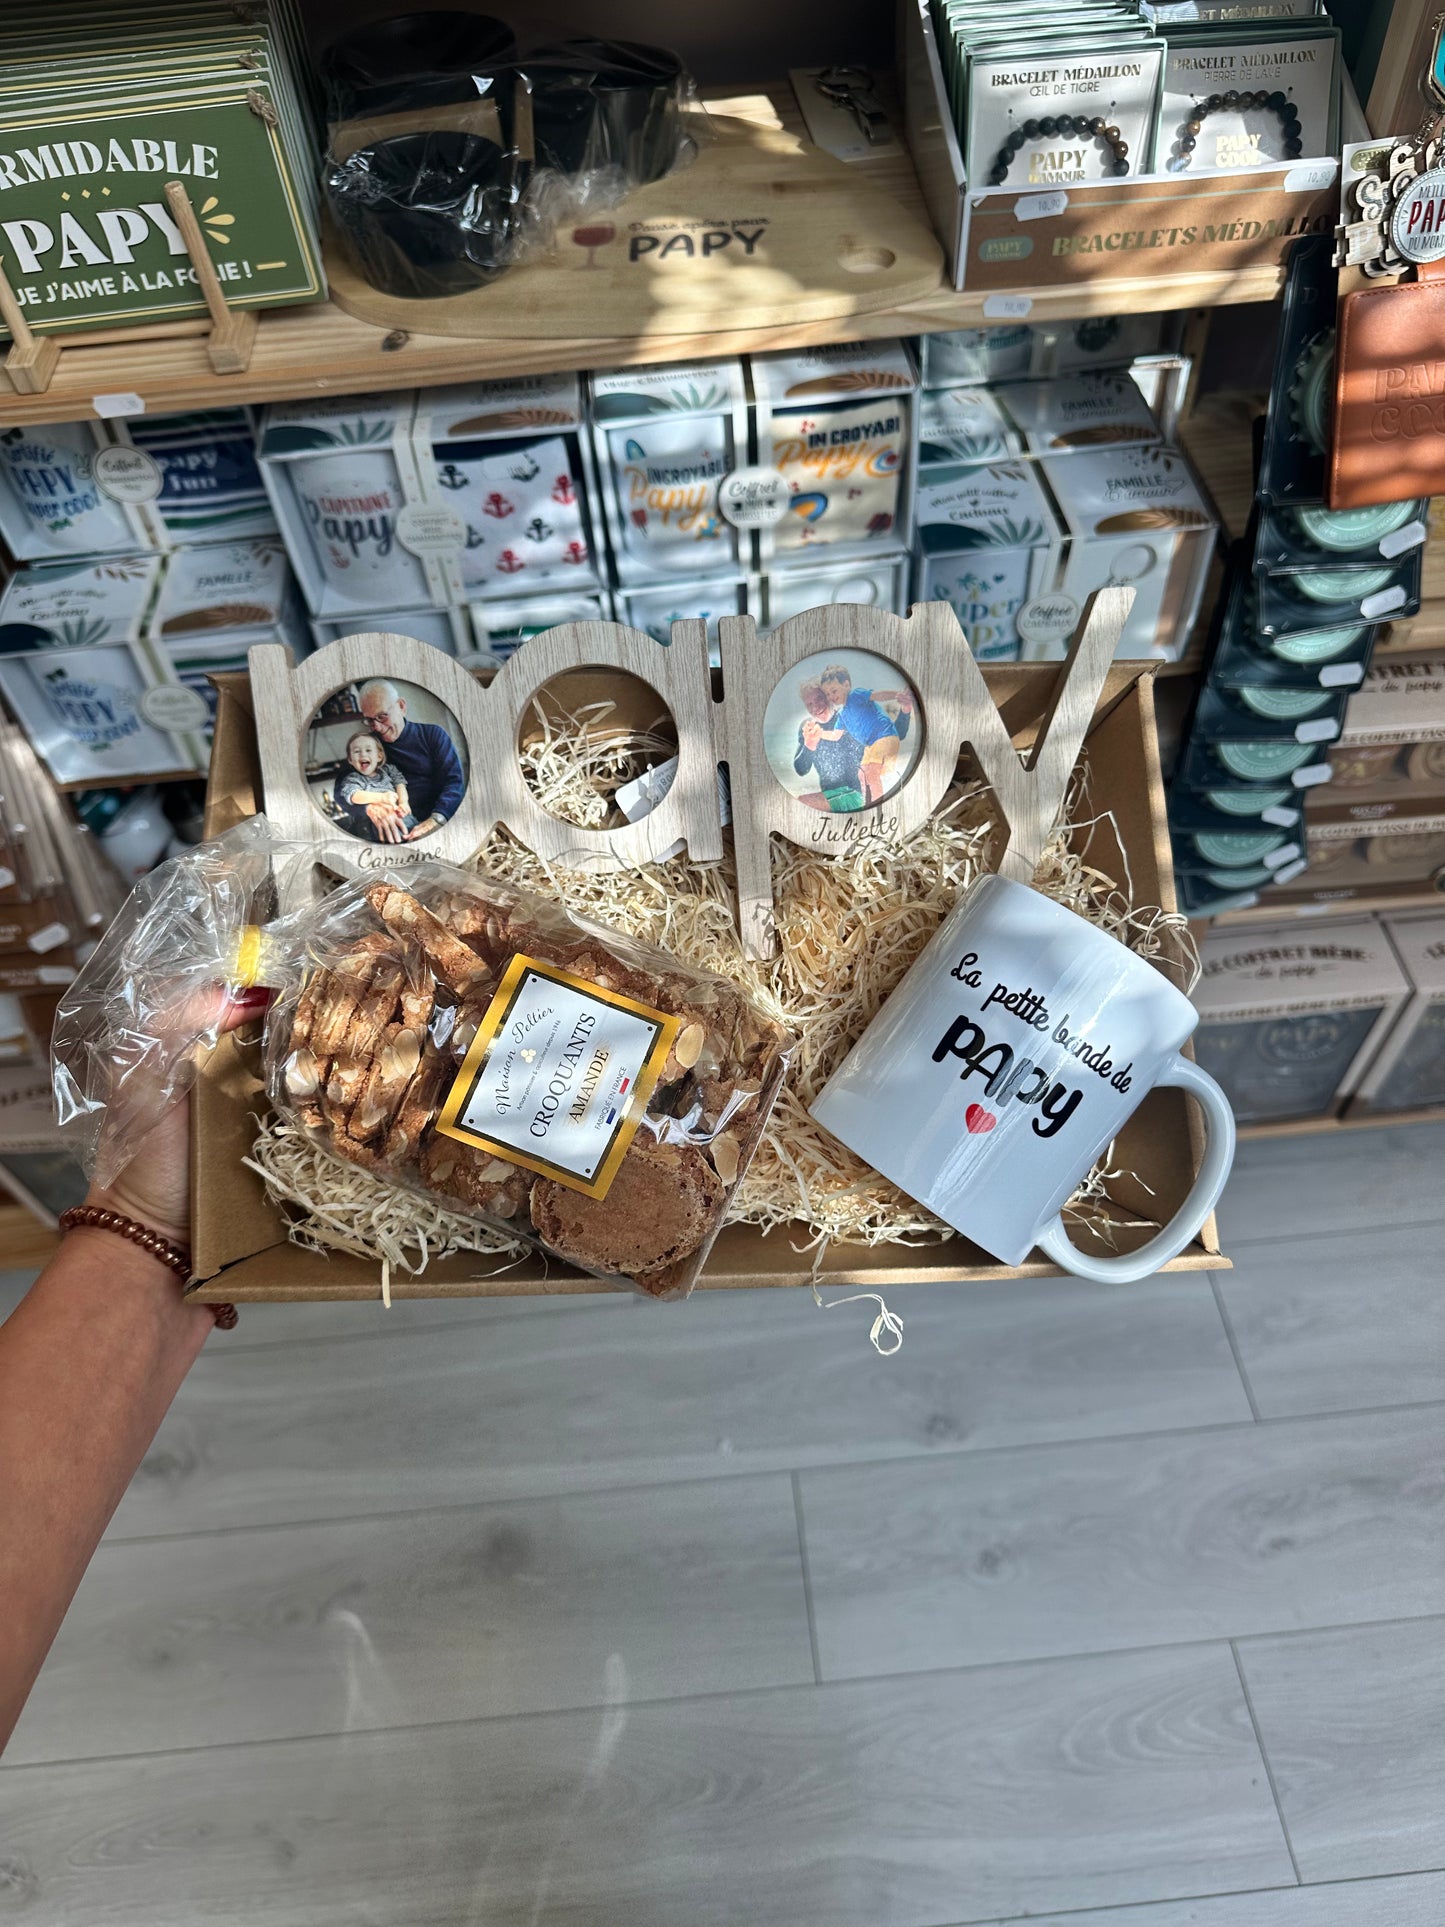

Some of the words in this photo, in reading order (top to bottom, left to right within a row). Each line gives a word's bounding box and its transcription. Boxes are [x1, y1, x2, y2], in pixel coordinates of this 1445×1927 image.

[992, 70, 1059, 86] BRACELET
[1064, 63, 1141, 80] MÉDAILLON
[1173, 56, 1236, 70] BRACELET
[1241, 50, 1316, 67] MÉDAILLON
[1204, 69, 1236, 81] PIERRE
[1240, 68, 1251, 80] DE
[1256, 67, 1281, 79] LAVE
[1053, 83, 1066, 95] DE
[1071, 81, 1101, 93] TIGRE
[1215, 134, 1262, 151] PAPY
[1028, 150, 1088, 171] PAPY
[1215, 150, 1262, 168] COOL
[1, 201, 193, 274] PAPY
[629, 228, 766, 262] PAPY
[1052, 226, 1197, 256] BRACELETS
[122, 271, 140, 295] À
[141, 270, 172, 291] LA
[178, 261, 242, 286] FOIE
[1105, 475, 1164, 490] FAMILLE
[624, 467, 710, 531] Papy
[1028, 606, 1073, 620] Coffret
[812, 814, 899, 843] Juliette
[951, 953, 982, 988] La
[980, 983, 1050, 1032] petite
[1052, 1014, 1112, 1078] bande
[1111, 1063, 1133, 1094] de
[495, 1049, 516, 1115] Maison
[512, 1007, 555, 1045] Peltier
[529, 1013, 596, 1138] CROQUANTS
[568, 1049, 609, 1124] AMANDE
[594, 1100, 611, 1130] FABRIQUÉ
[608, 1090, 617, 1101] EN
[613, 1066, 627, 1091] FRANCE
